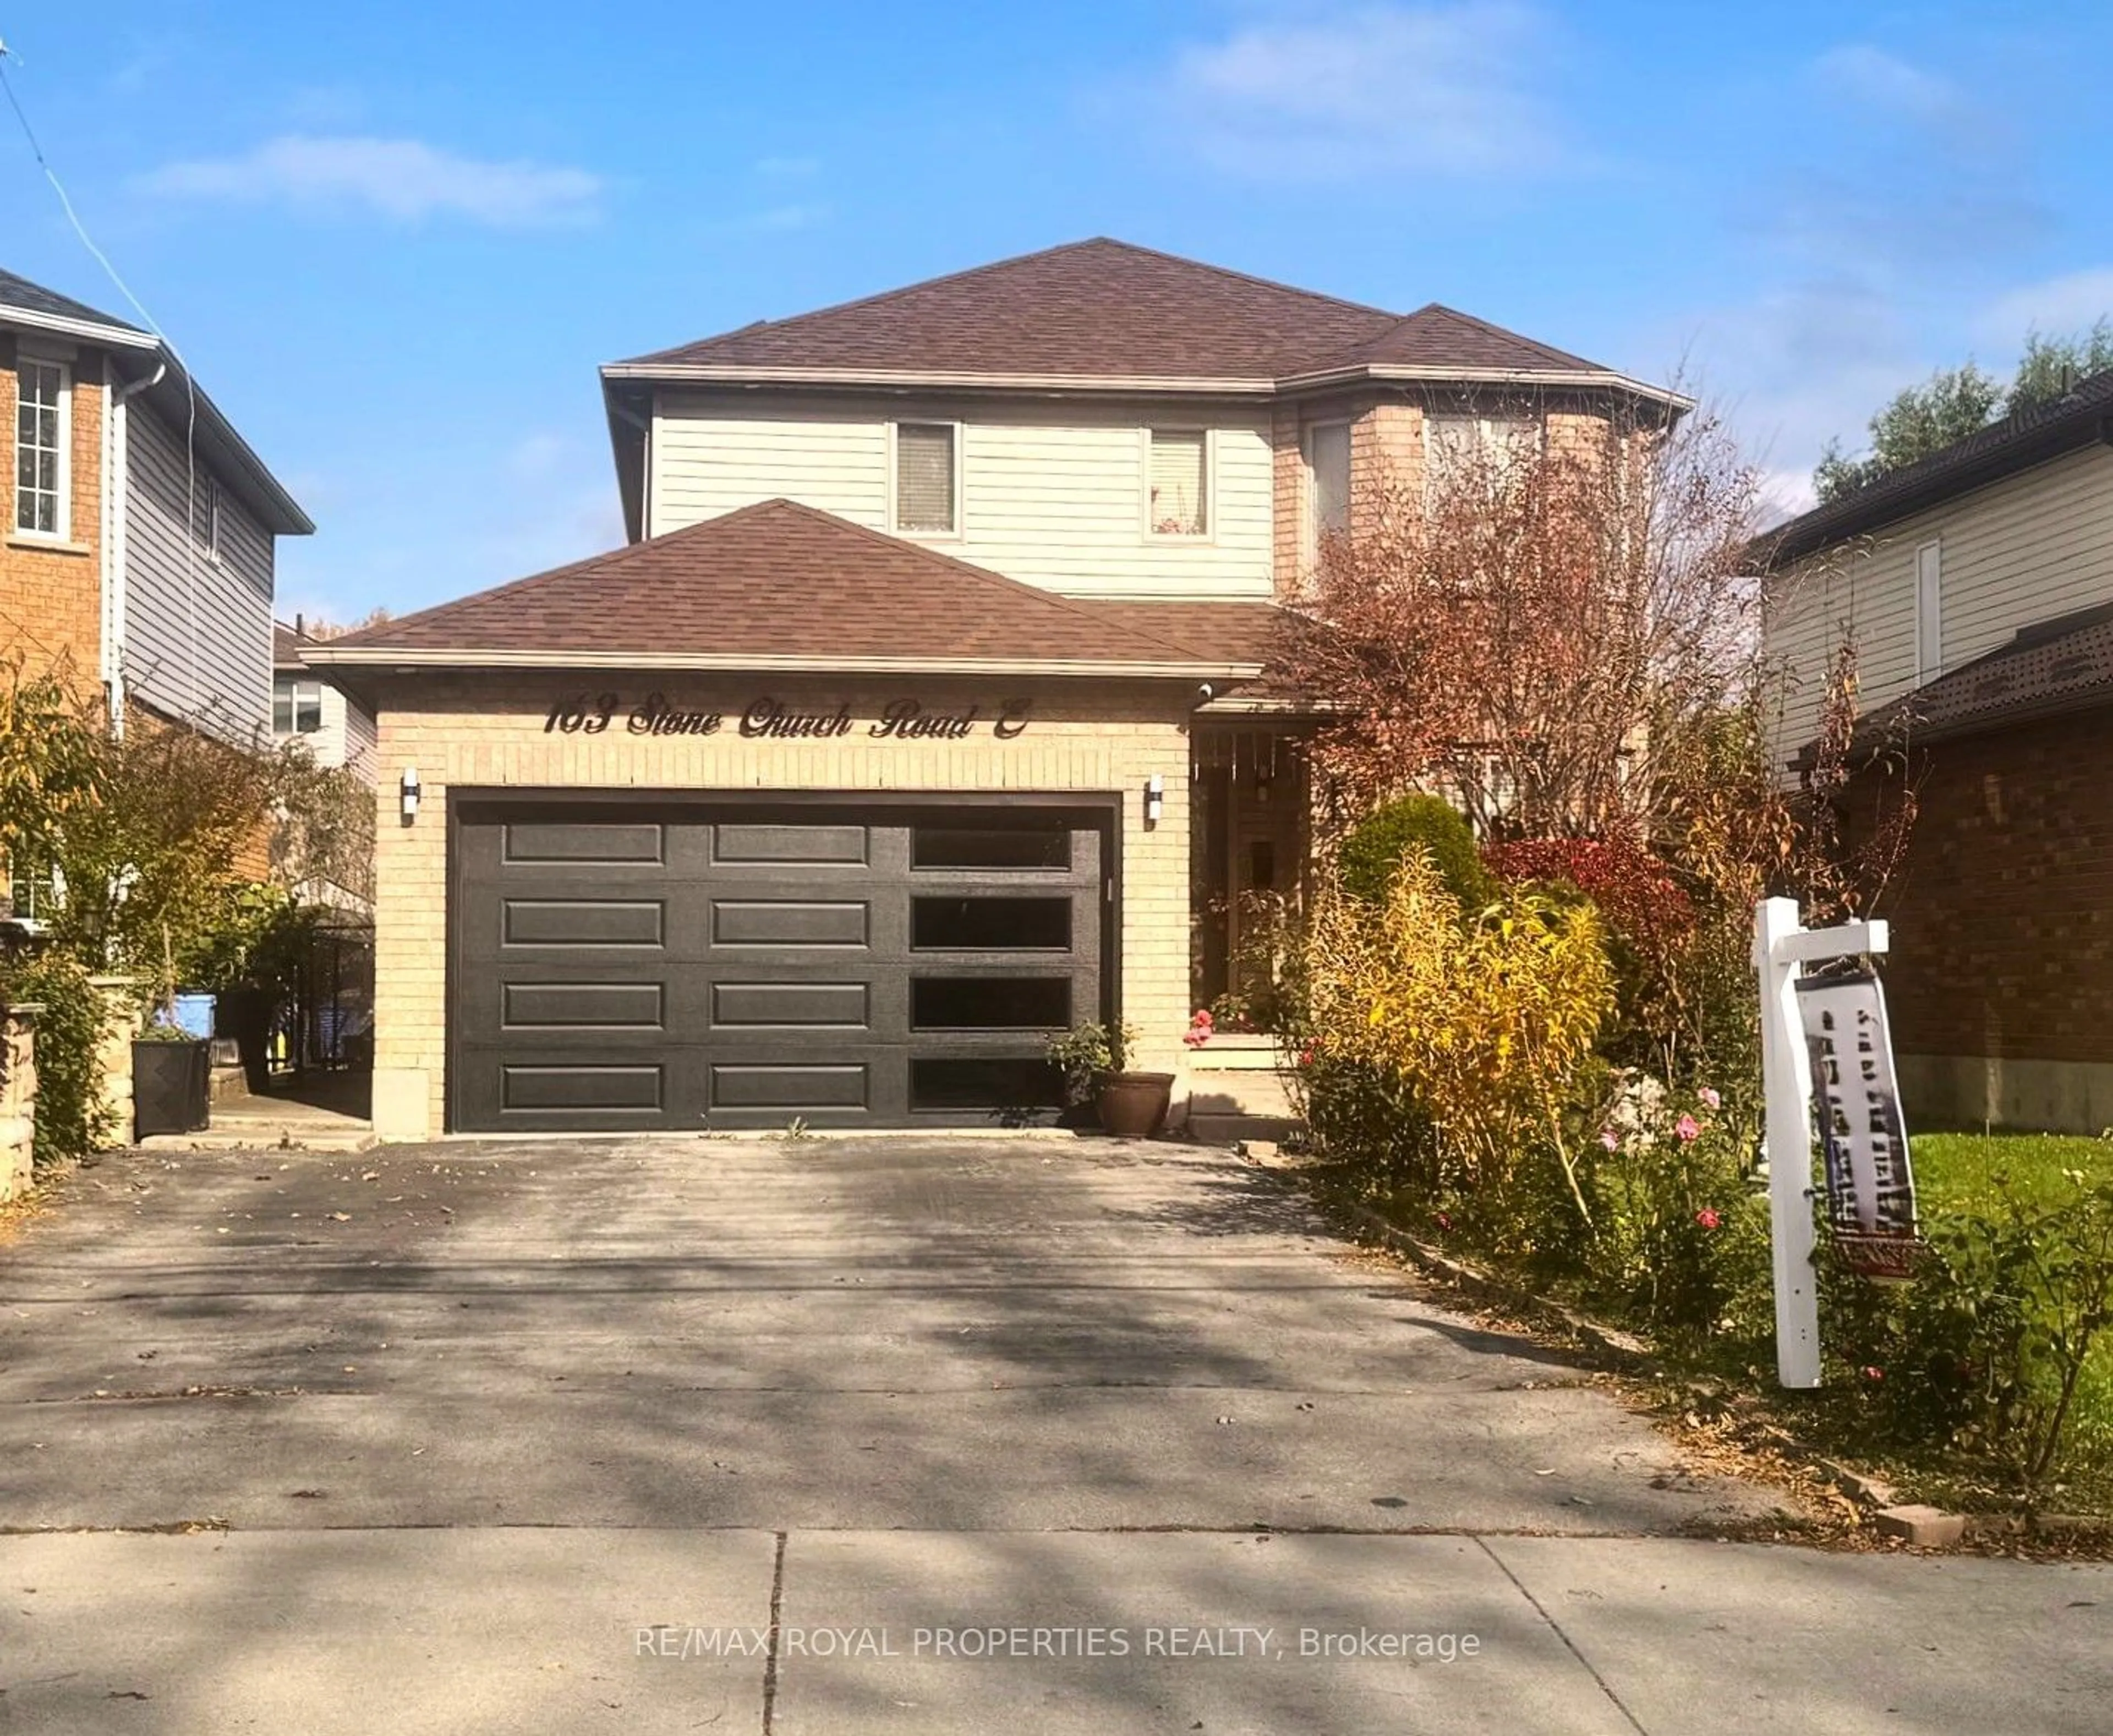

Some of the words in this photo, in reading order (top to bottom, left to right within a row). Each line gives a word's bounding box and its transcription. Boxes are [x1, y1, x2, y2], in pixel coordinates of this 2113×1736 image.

[544, 692, 618, 734] 163
[627, 692, 723, 736] Stone
[739, 697, 854, 738] Church
[868, 698, 979, 739] Road
